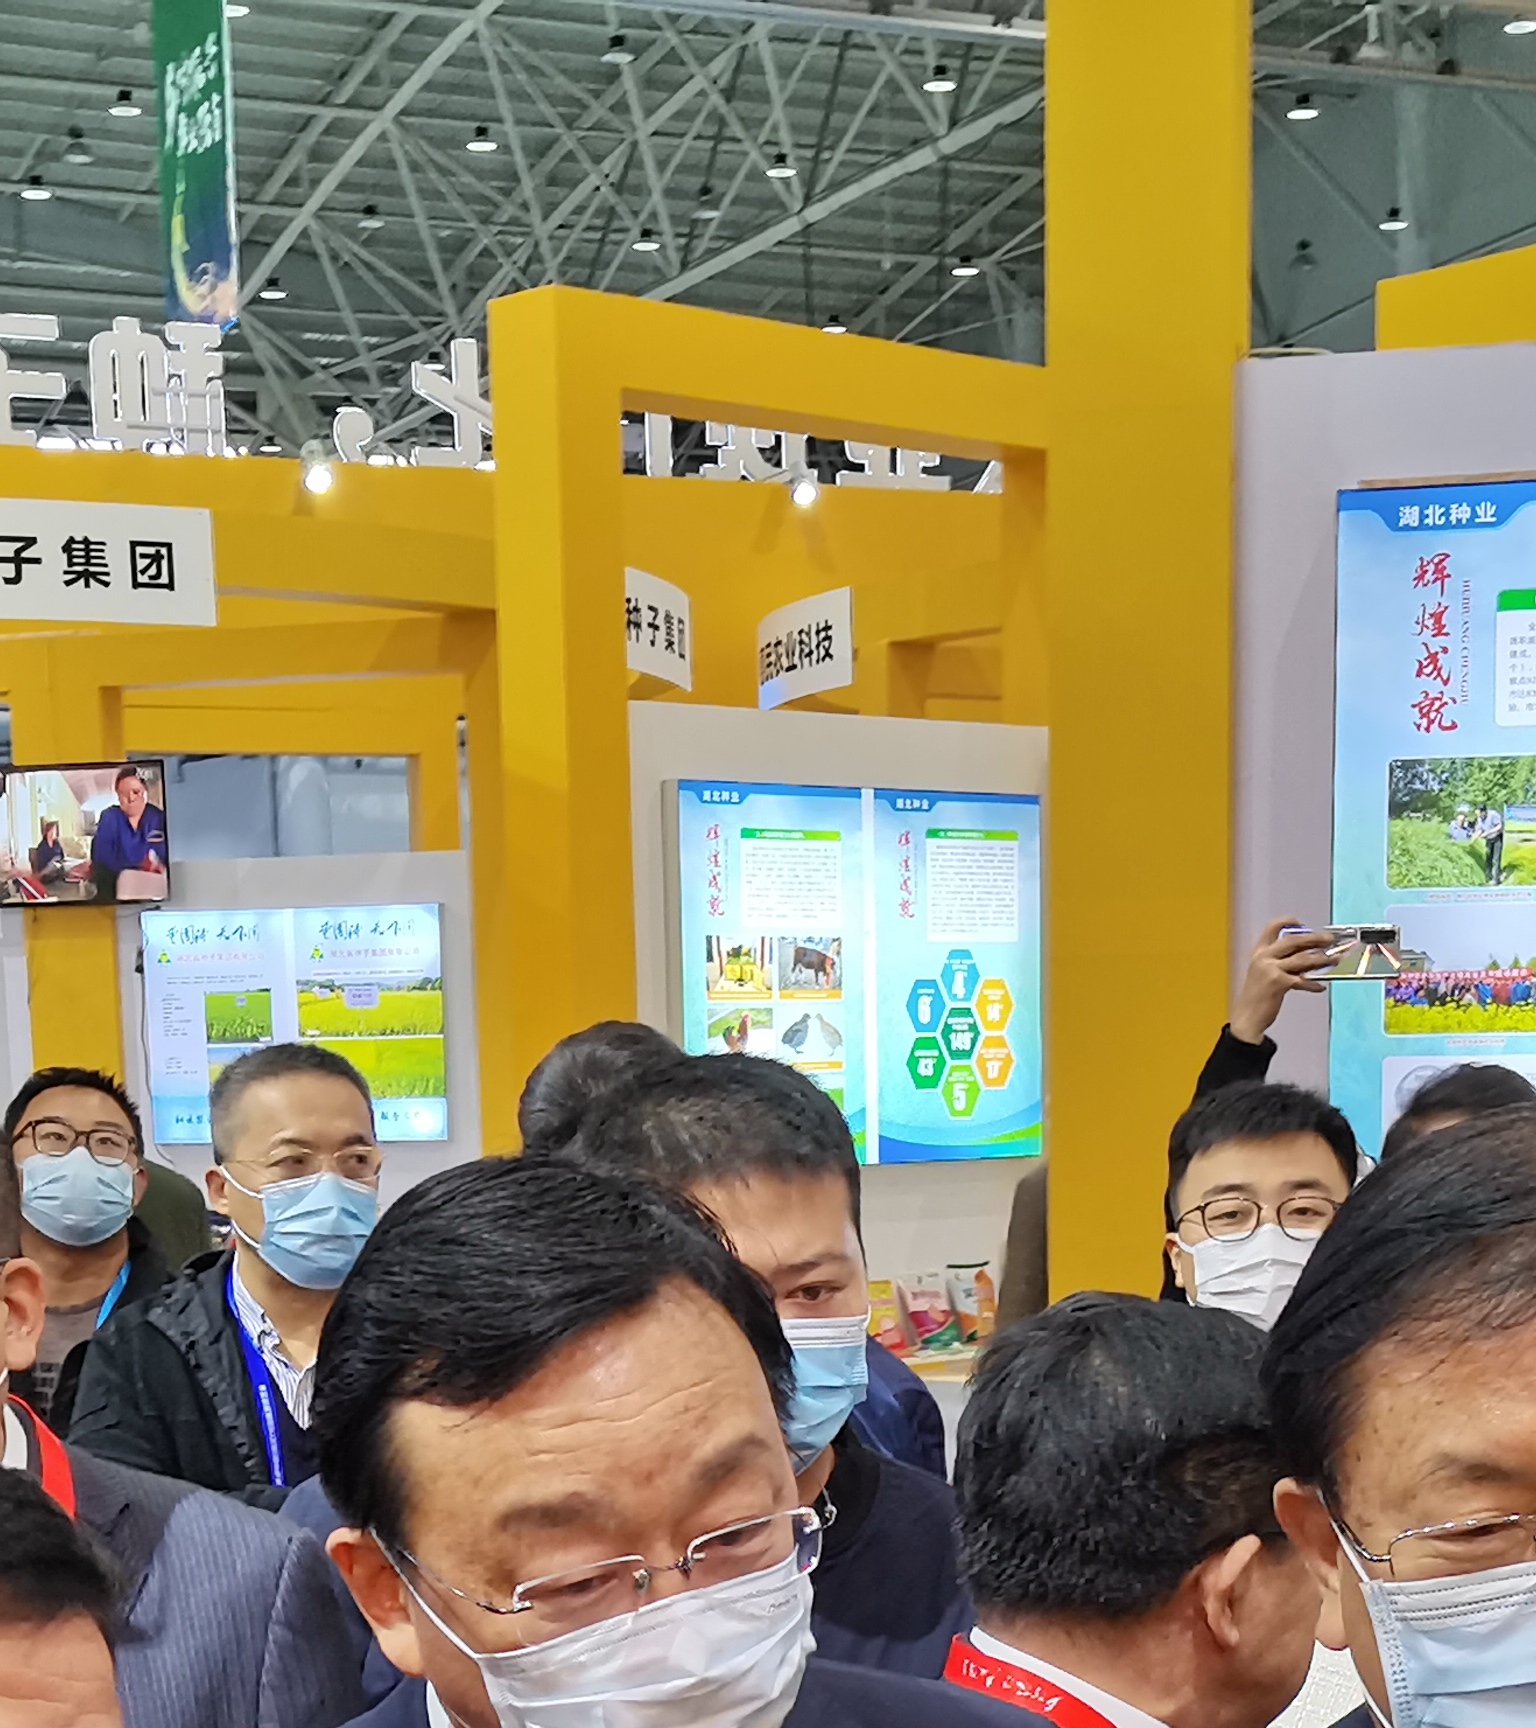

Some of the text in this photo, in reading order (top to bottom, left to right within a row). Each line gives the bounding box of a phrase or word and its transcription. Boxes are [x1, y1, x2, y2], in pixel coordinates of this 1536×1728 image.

[1398, 501, 1498, 528] 湖北种业
[1411, 553, 1459, 735] 辉煌成就
